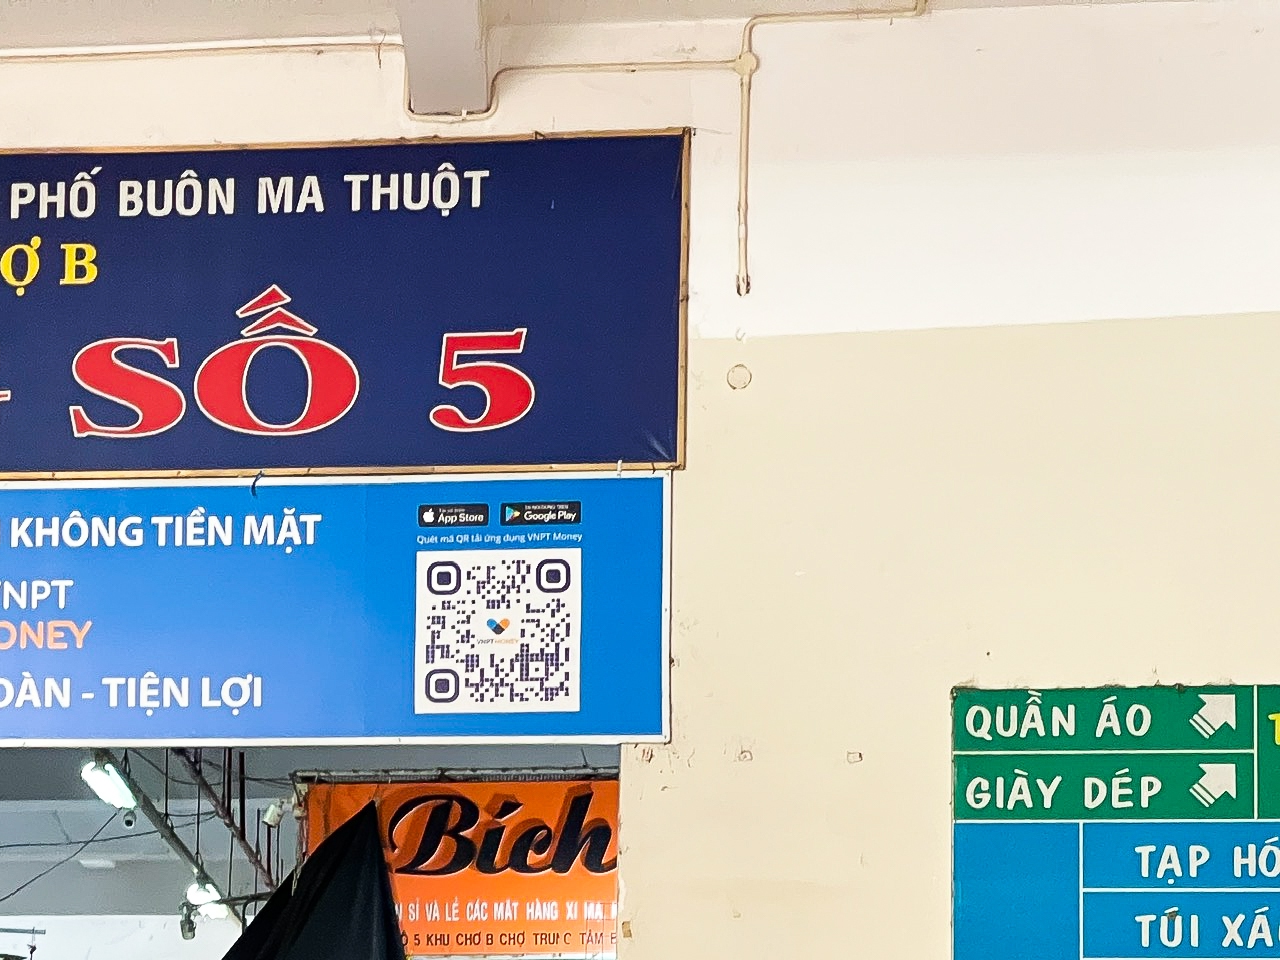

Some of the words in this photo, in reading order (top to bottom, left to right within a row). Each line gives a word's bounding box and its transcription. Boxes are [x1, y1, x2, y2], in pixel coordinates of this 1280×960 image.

[10, 167, 103, 220] PHỐ
[118, 171, 236, 217] BUÔN
[257, 176, 324, 213] MA
[343, 162, 490, 217] THUỘT
[60, 243, 98, 286] B
[69, 283, 361, 440] SỐ
[429, 327, 538, 434] 5
[9, 509, 144, 548] KHÔNG
[147, 505, 235, 547] TIỀN
[242, 508, 323, 555] MẶT
[438, 513, 458, 523] App
[459, 513, 484, 522] Store
[524, 511, 557, 522] Google
[558, 511, 577, 522] Play
[417, 534, 438, 544] Quét
[456, 534, 469, 544] QR
[527, 533, 551, 542] VNPT
[552, 532, 582, 542] Money
[101, 673, 194, 717] TIỆN
[201, 672, 263, 715] LỢI
[965, 690, 1076, 741] QUẦN
[1095, 696, 1152, 738] ÁO
[965, 769, 1063, 810] GIÀY
[1084, 768, 1163, 809] DÉP
[388, 790, 617, 875] Bích
[1134, 844, 1211, 886] TẠP
[425, 900, 440, 921] VÀ
[466, 899, 488, 921] CÁC
[526, 898, 558, 920] HÀNG
[566, 902, 578, 920] XI
[1135, 907, 1199, 947] TÚI
[1221, 906, 1280, 948] XÁ
[414, 934, 420, 945] 5
[426, 934, 450, 945] KHU
[486, 933, 493, 945] B
